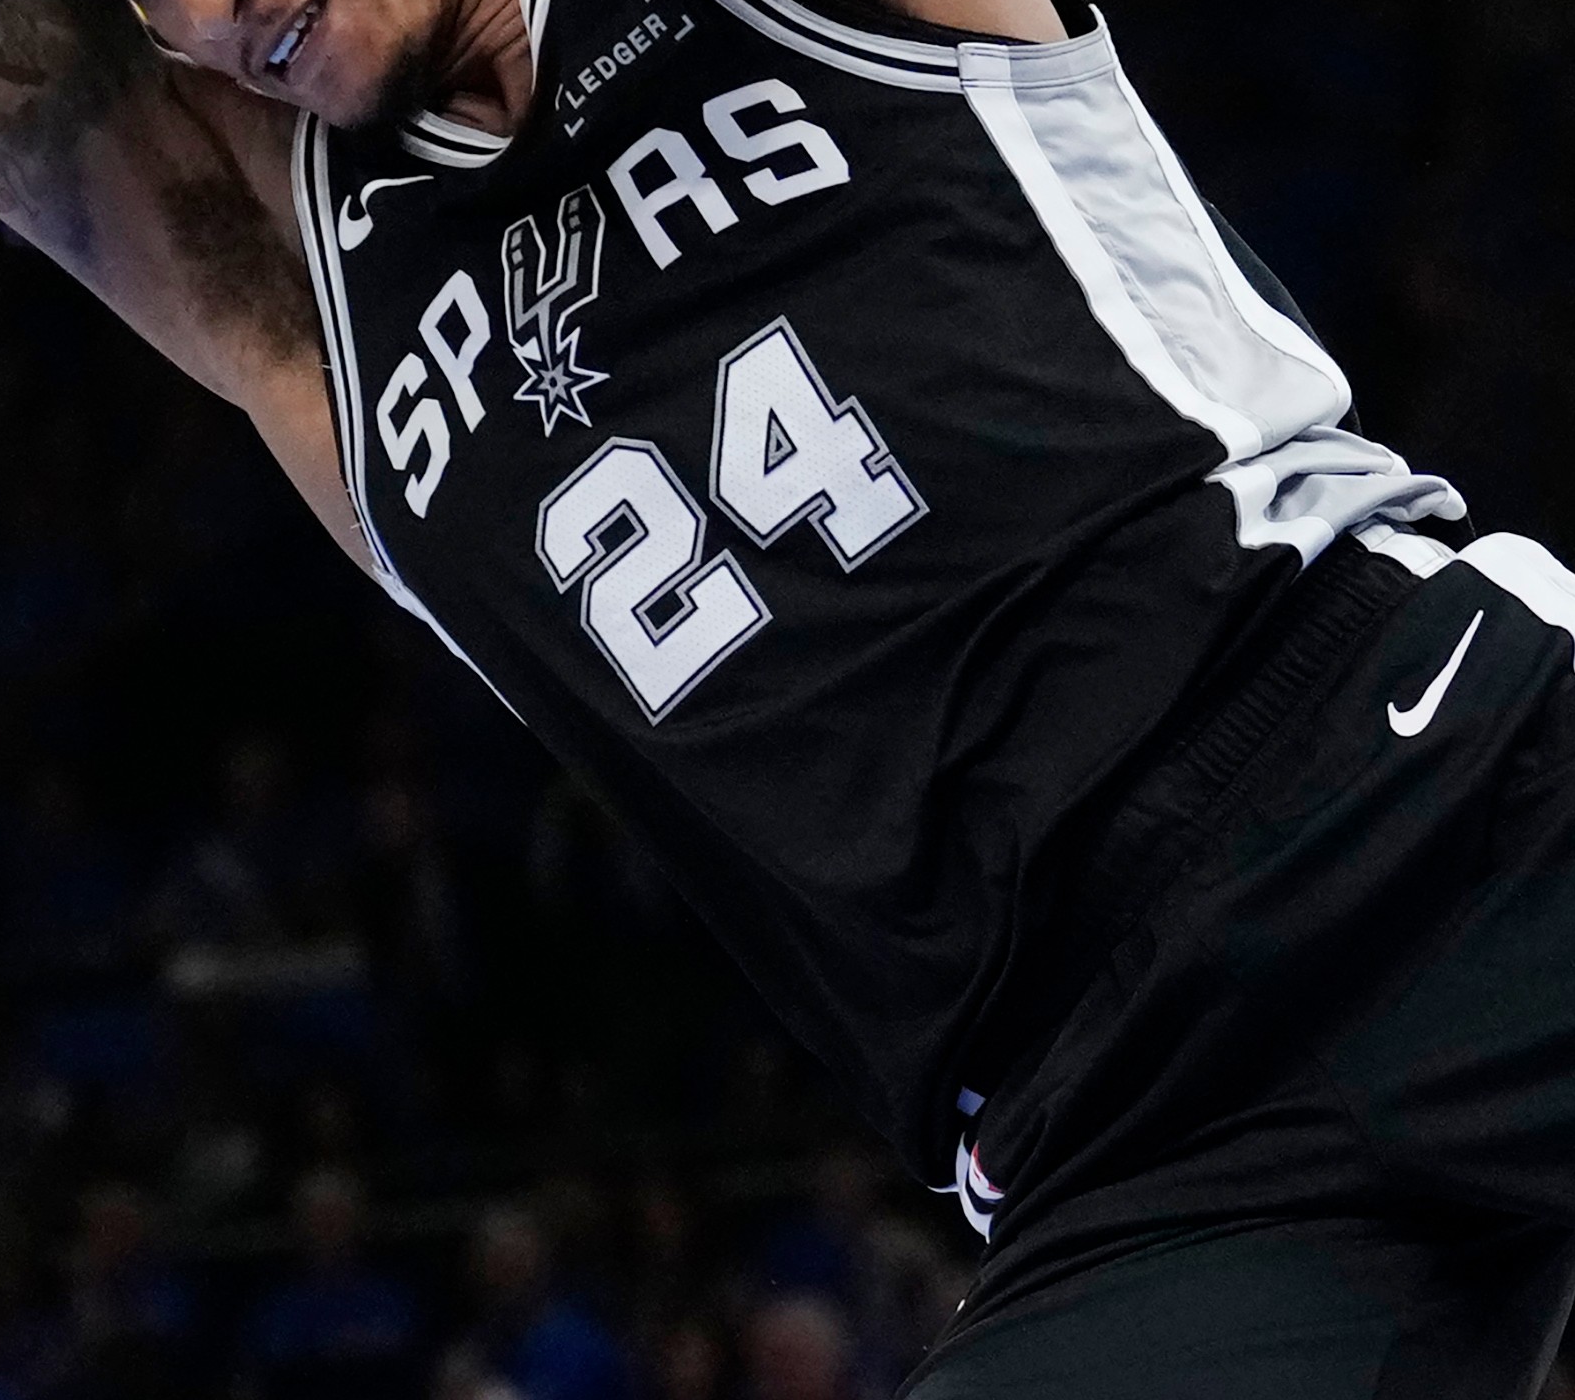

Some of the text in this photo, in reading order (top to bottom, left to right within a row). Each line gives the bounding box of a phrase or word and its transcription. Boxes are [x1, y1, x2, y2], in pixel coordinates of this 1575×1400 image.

[565, 13, 668, 110] LEDGER
[377, 78, 850, 518] SPURS
[535, 315, 930, 726] 24
